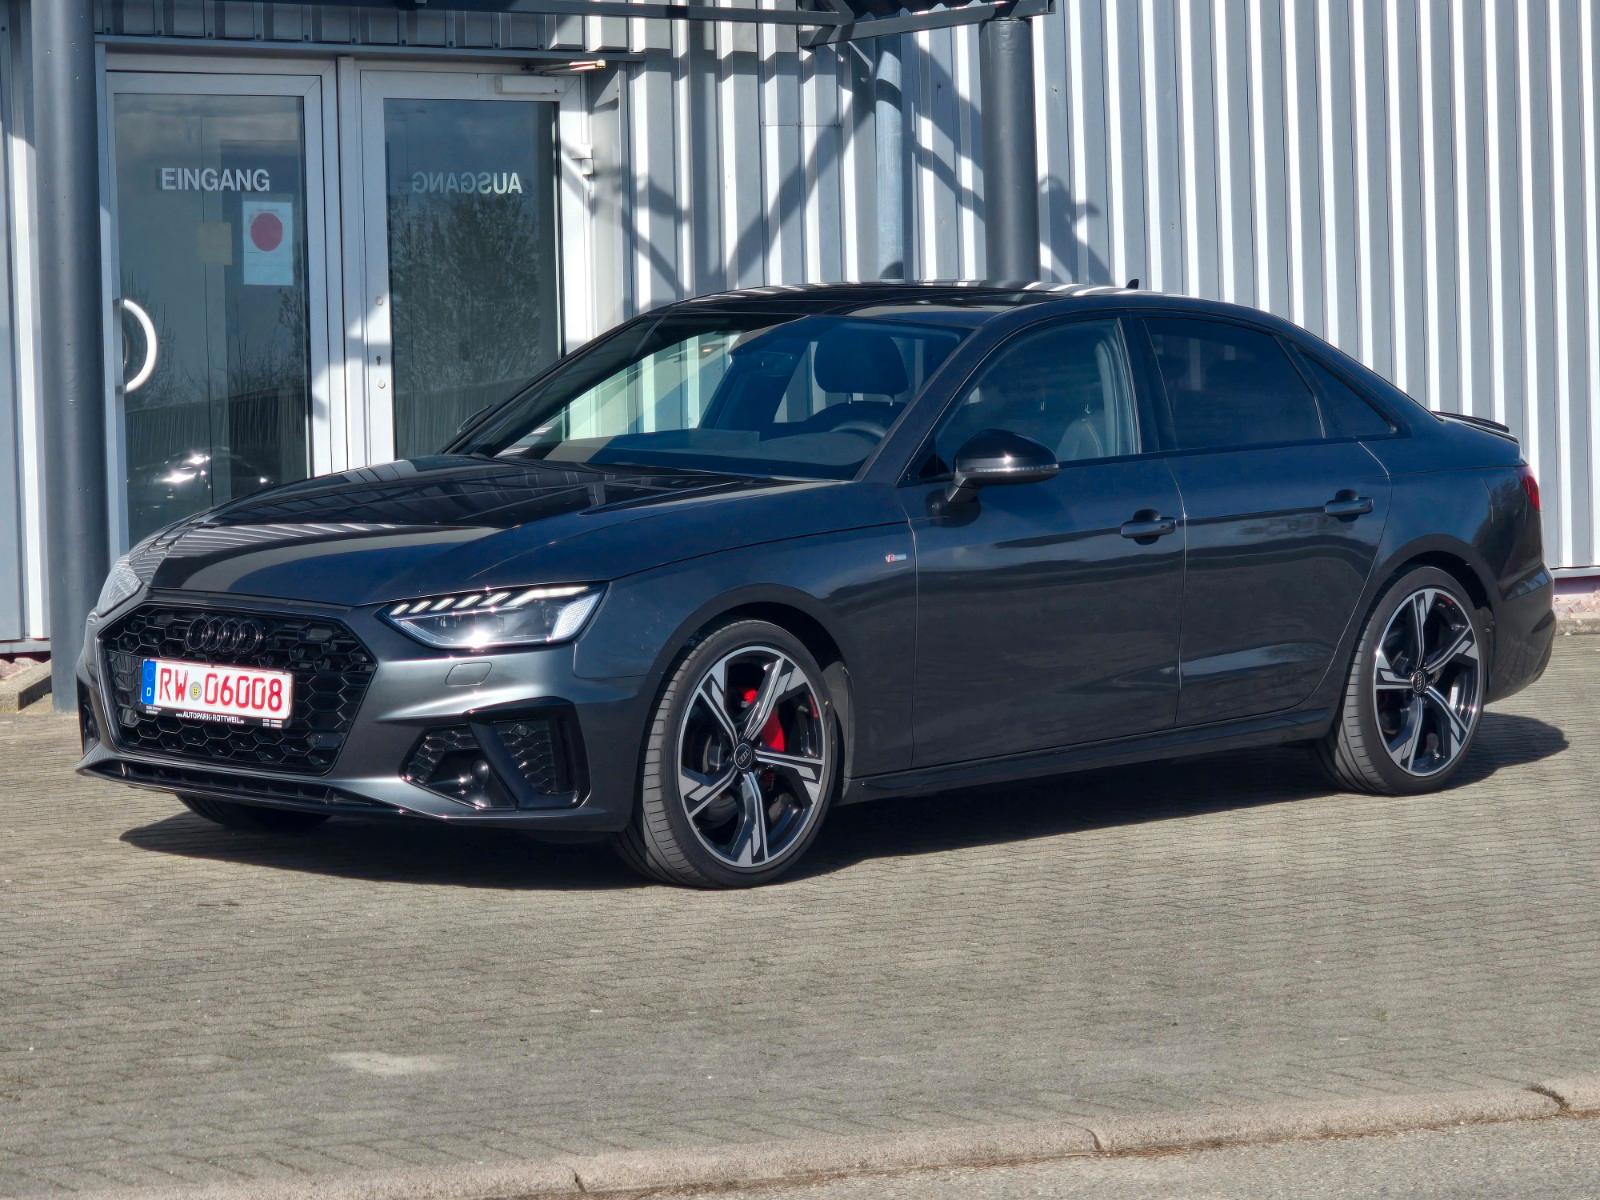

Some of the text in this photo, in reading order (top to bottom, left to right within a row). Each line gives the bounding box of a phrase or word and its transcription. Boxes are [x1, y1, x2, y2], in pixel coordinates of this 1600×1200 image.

[161, 167, 270, 192] EINGANG
[146, 687, 152, 697] D
[159, 667, 283, 712] RW 06008
